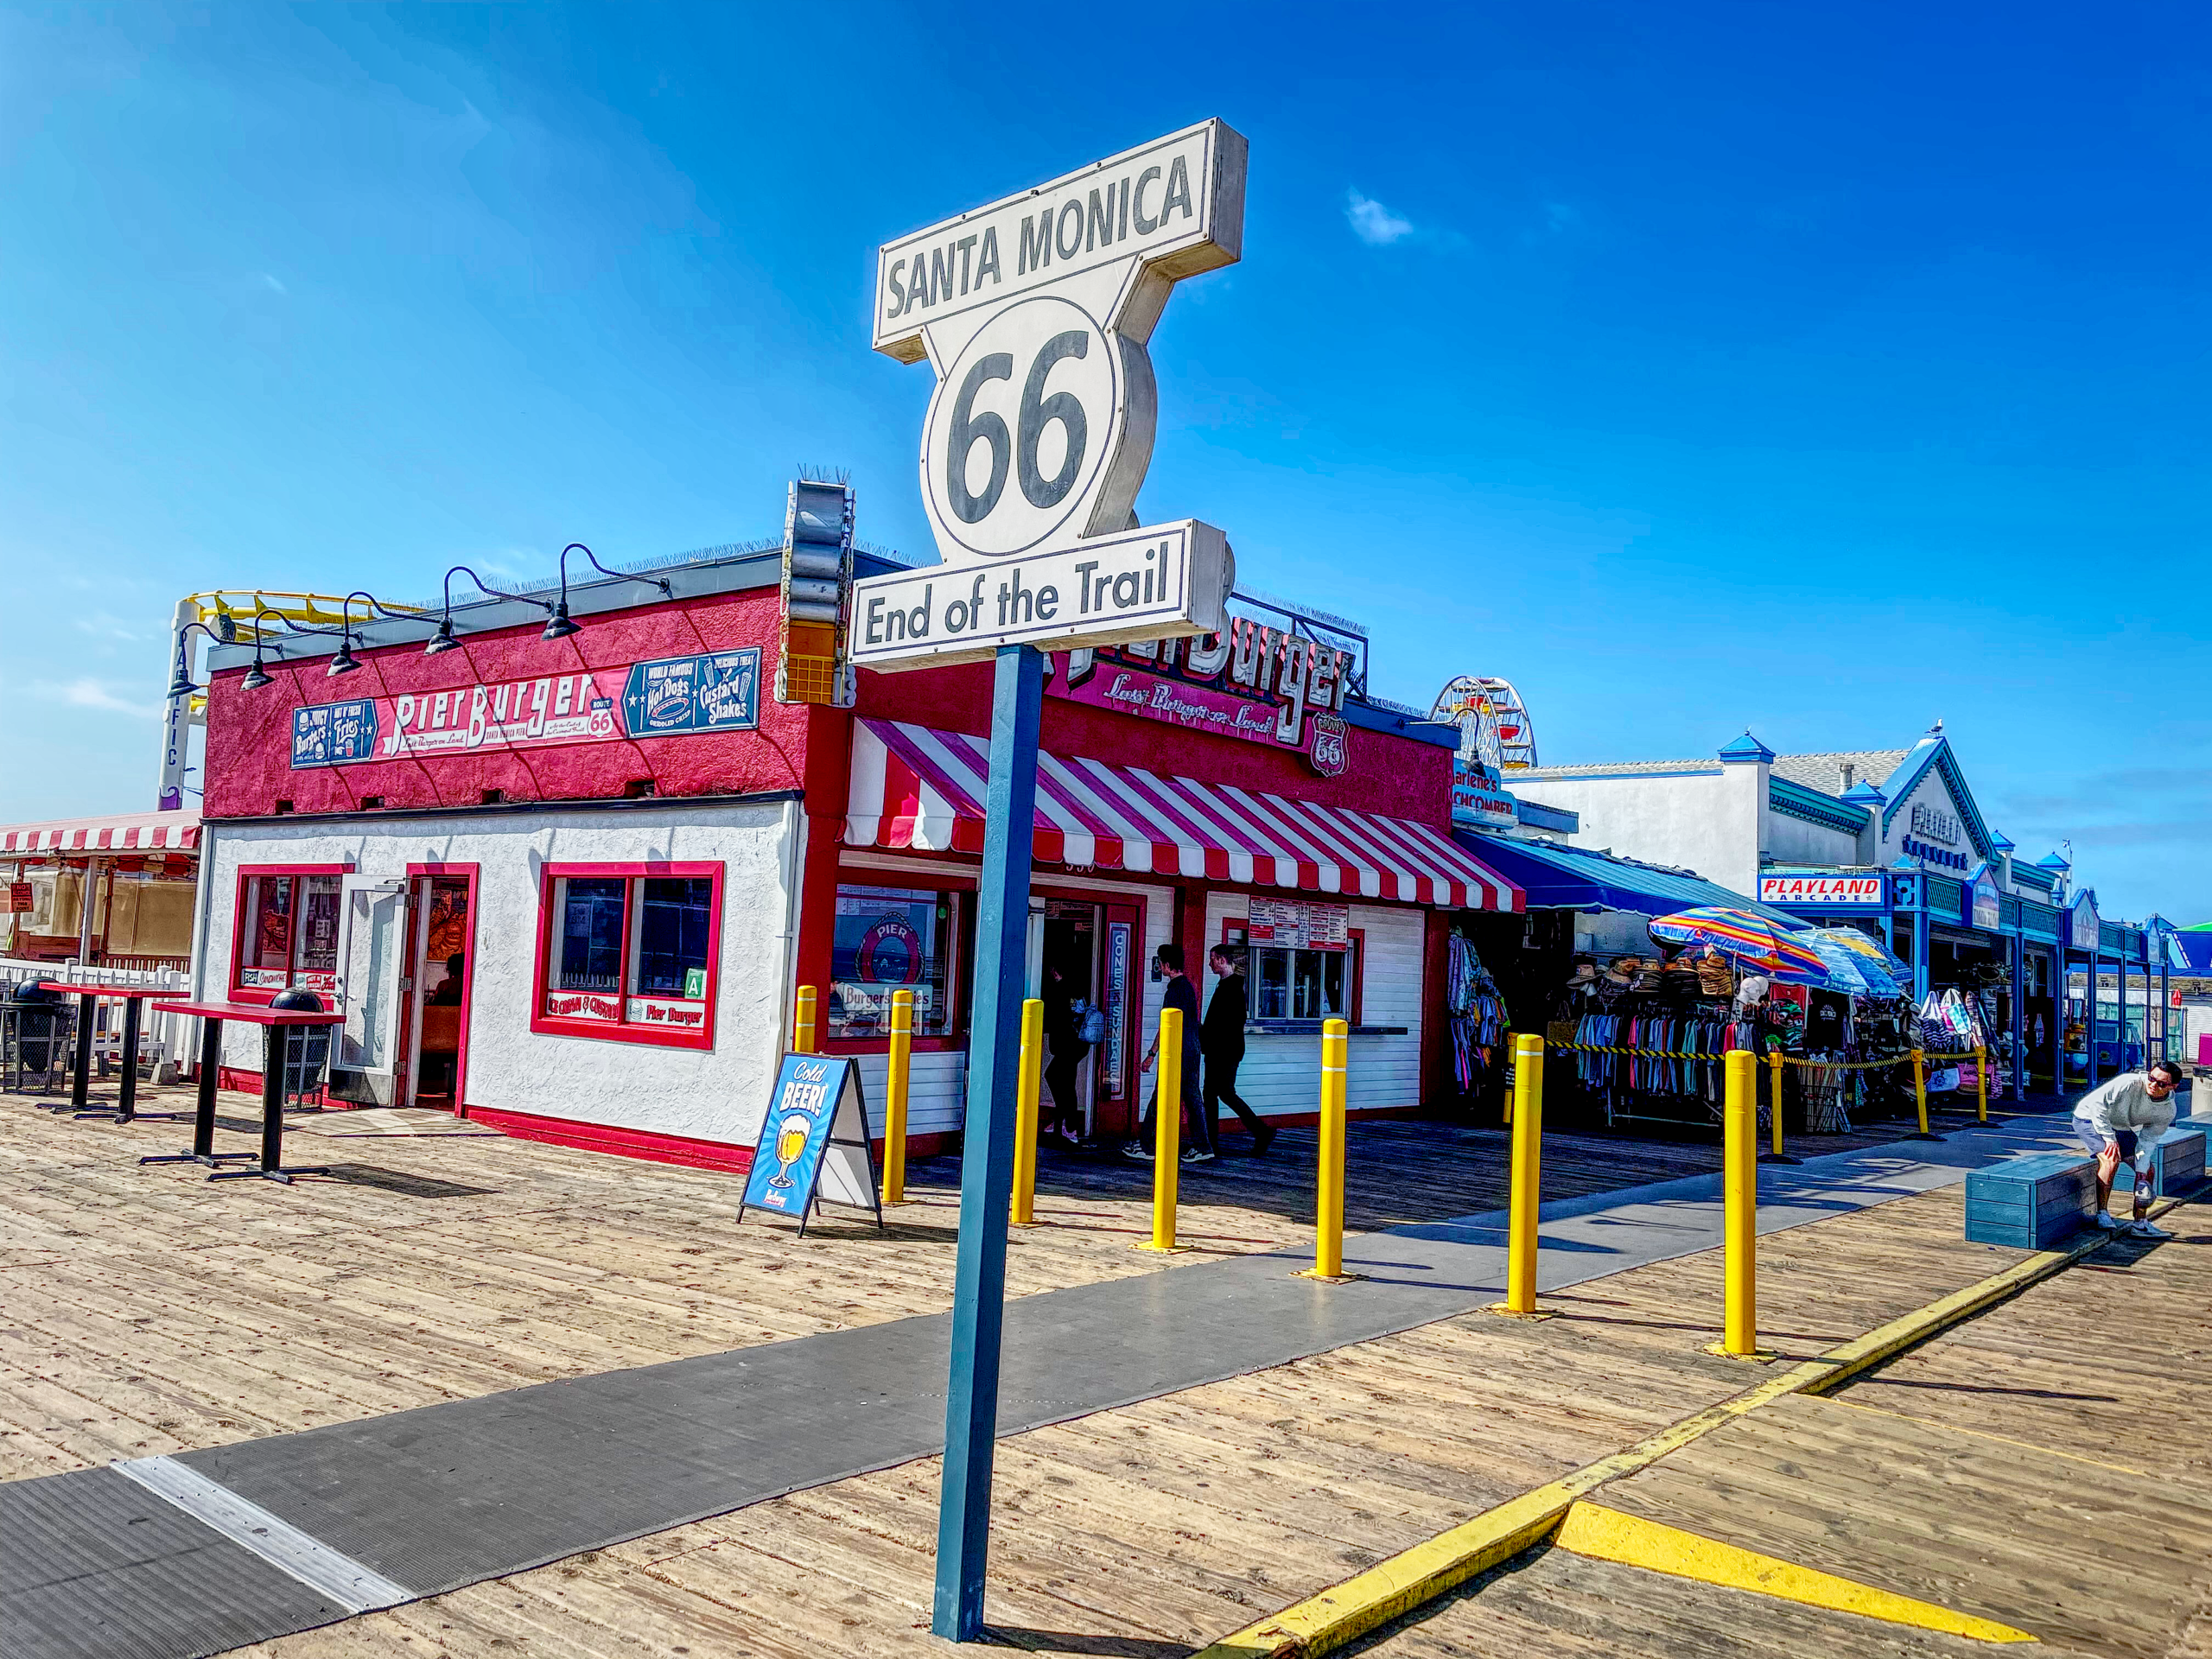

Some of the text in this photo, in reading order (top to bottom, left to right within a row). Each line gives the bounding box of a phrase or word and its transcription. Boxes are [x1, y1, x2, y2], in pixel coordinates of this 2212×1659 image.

[887, 155, 1192, 319] SANTA MONICA
[947, 330, 1089, 524] 66
[865, 541, 1169, 644] End of the Trail
[649, 663, 694, 679] WORLD FAMOUS
[714, 655, 754, 669] DELICIOUS TREAT
[168, 630, 187, 766] PAIFIC
[647, 677, 690, 718] Hot Dogs
[700, 675, 739, 709] Custard
[593, 700, 610, 709] ROUTE
[709, 699, 747, 725] Shakes
[590, 712, 610, 732] 66
[649, 709, 691, 728] GRIDDLED CRISP
[296, 726, 327, 756] Burgers
[334, 718, 359, 746] Fries
[446, 733, 465, 744] Land
[1316, 735, 1341, 766] 66
[1453, 771, 1497, 793] arlene's
[1452, 791, 1513, 815] CHCOMBER
[1764, 880, 1878, 894] PLAYLAND
[877, 924, 907, 939] PIER
[1114, 935, 1123, 990] CONES
[245, 973, 257, 983] FISH
[688, 977, 699, 995] A
[844, 988, 891, 1008] Burgers
[646, 1005, 704, 1026] Pier Burger
[793, 1061, 828, 1083] Cold
[779, 1081, 827, 1119] BEER!
